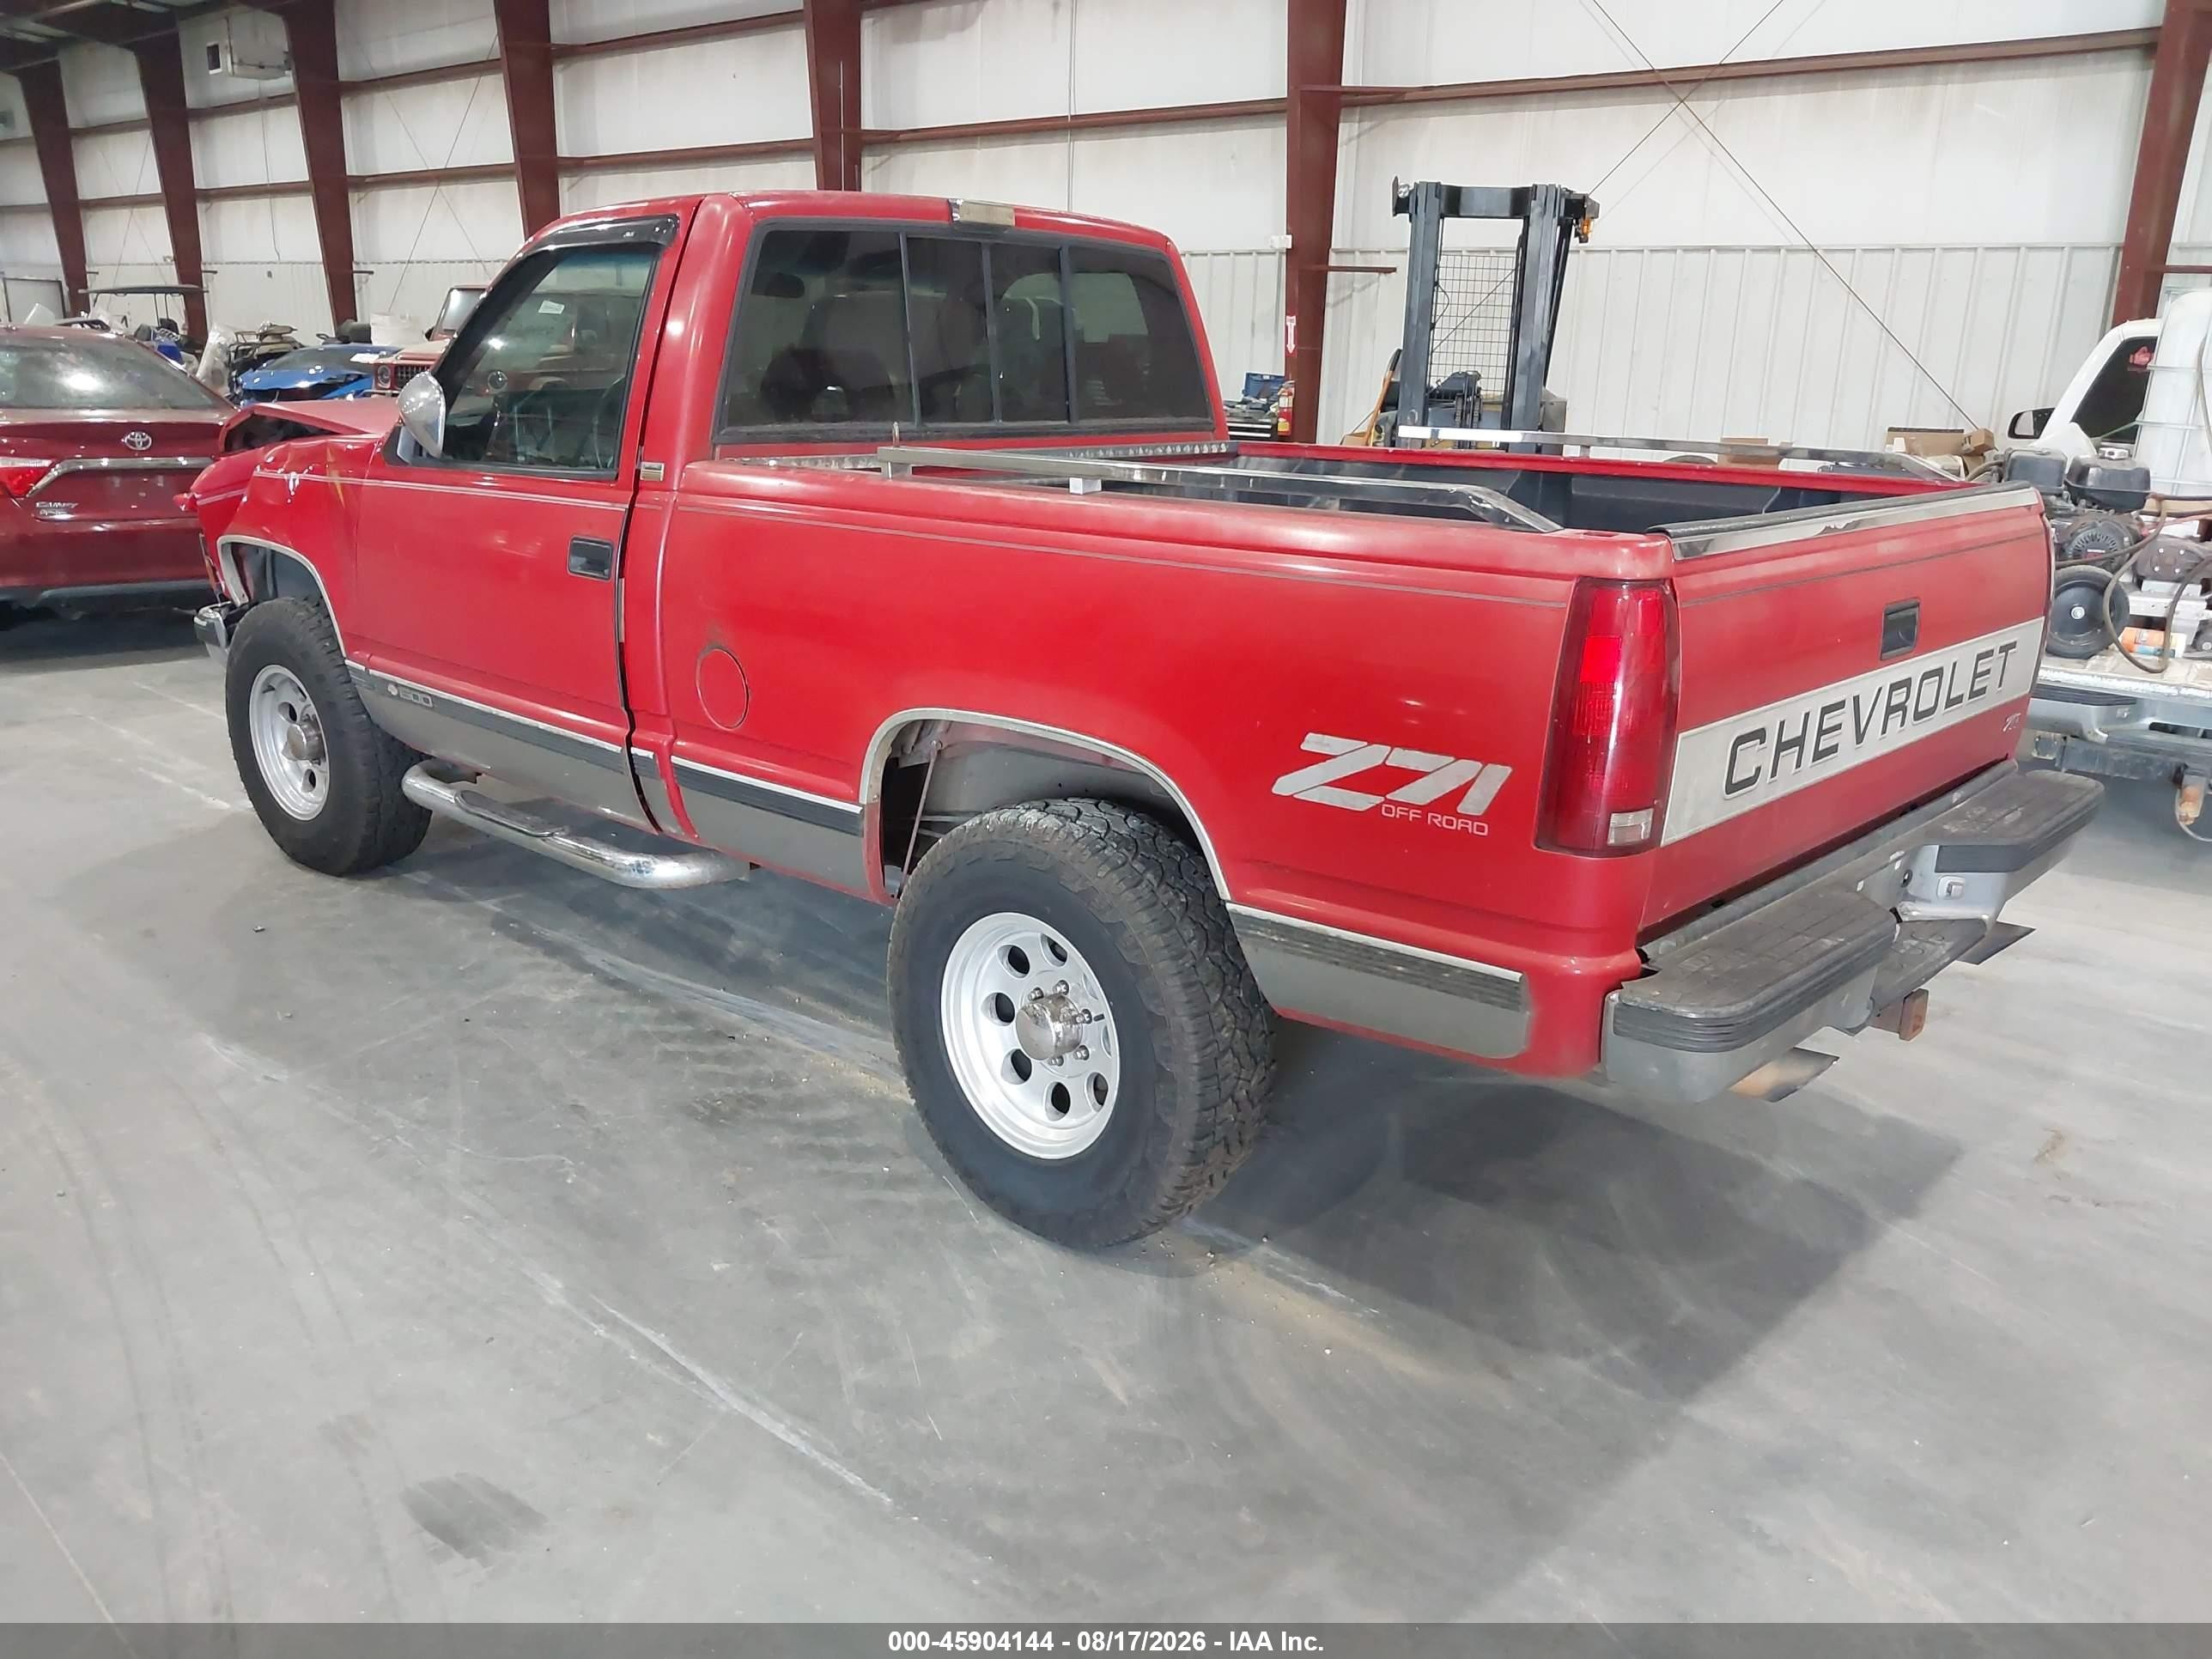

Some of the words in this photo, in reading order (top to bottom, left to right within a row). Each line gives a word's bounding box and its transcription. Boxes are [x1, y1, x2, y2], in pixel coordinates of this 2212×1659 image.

[1723, 641, 2018, 800] CHEVROLET
[1272, 732, 1512, 816] Z71
[1381, 803, 1422, 822] OFF
[1427, 812, 1489, 836] ROAD
